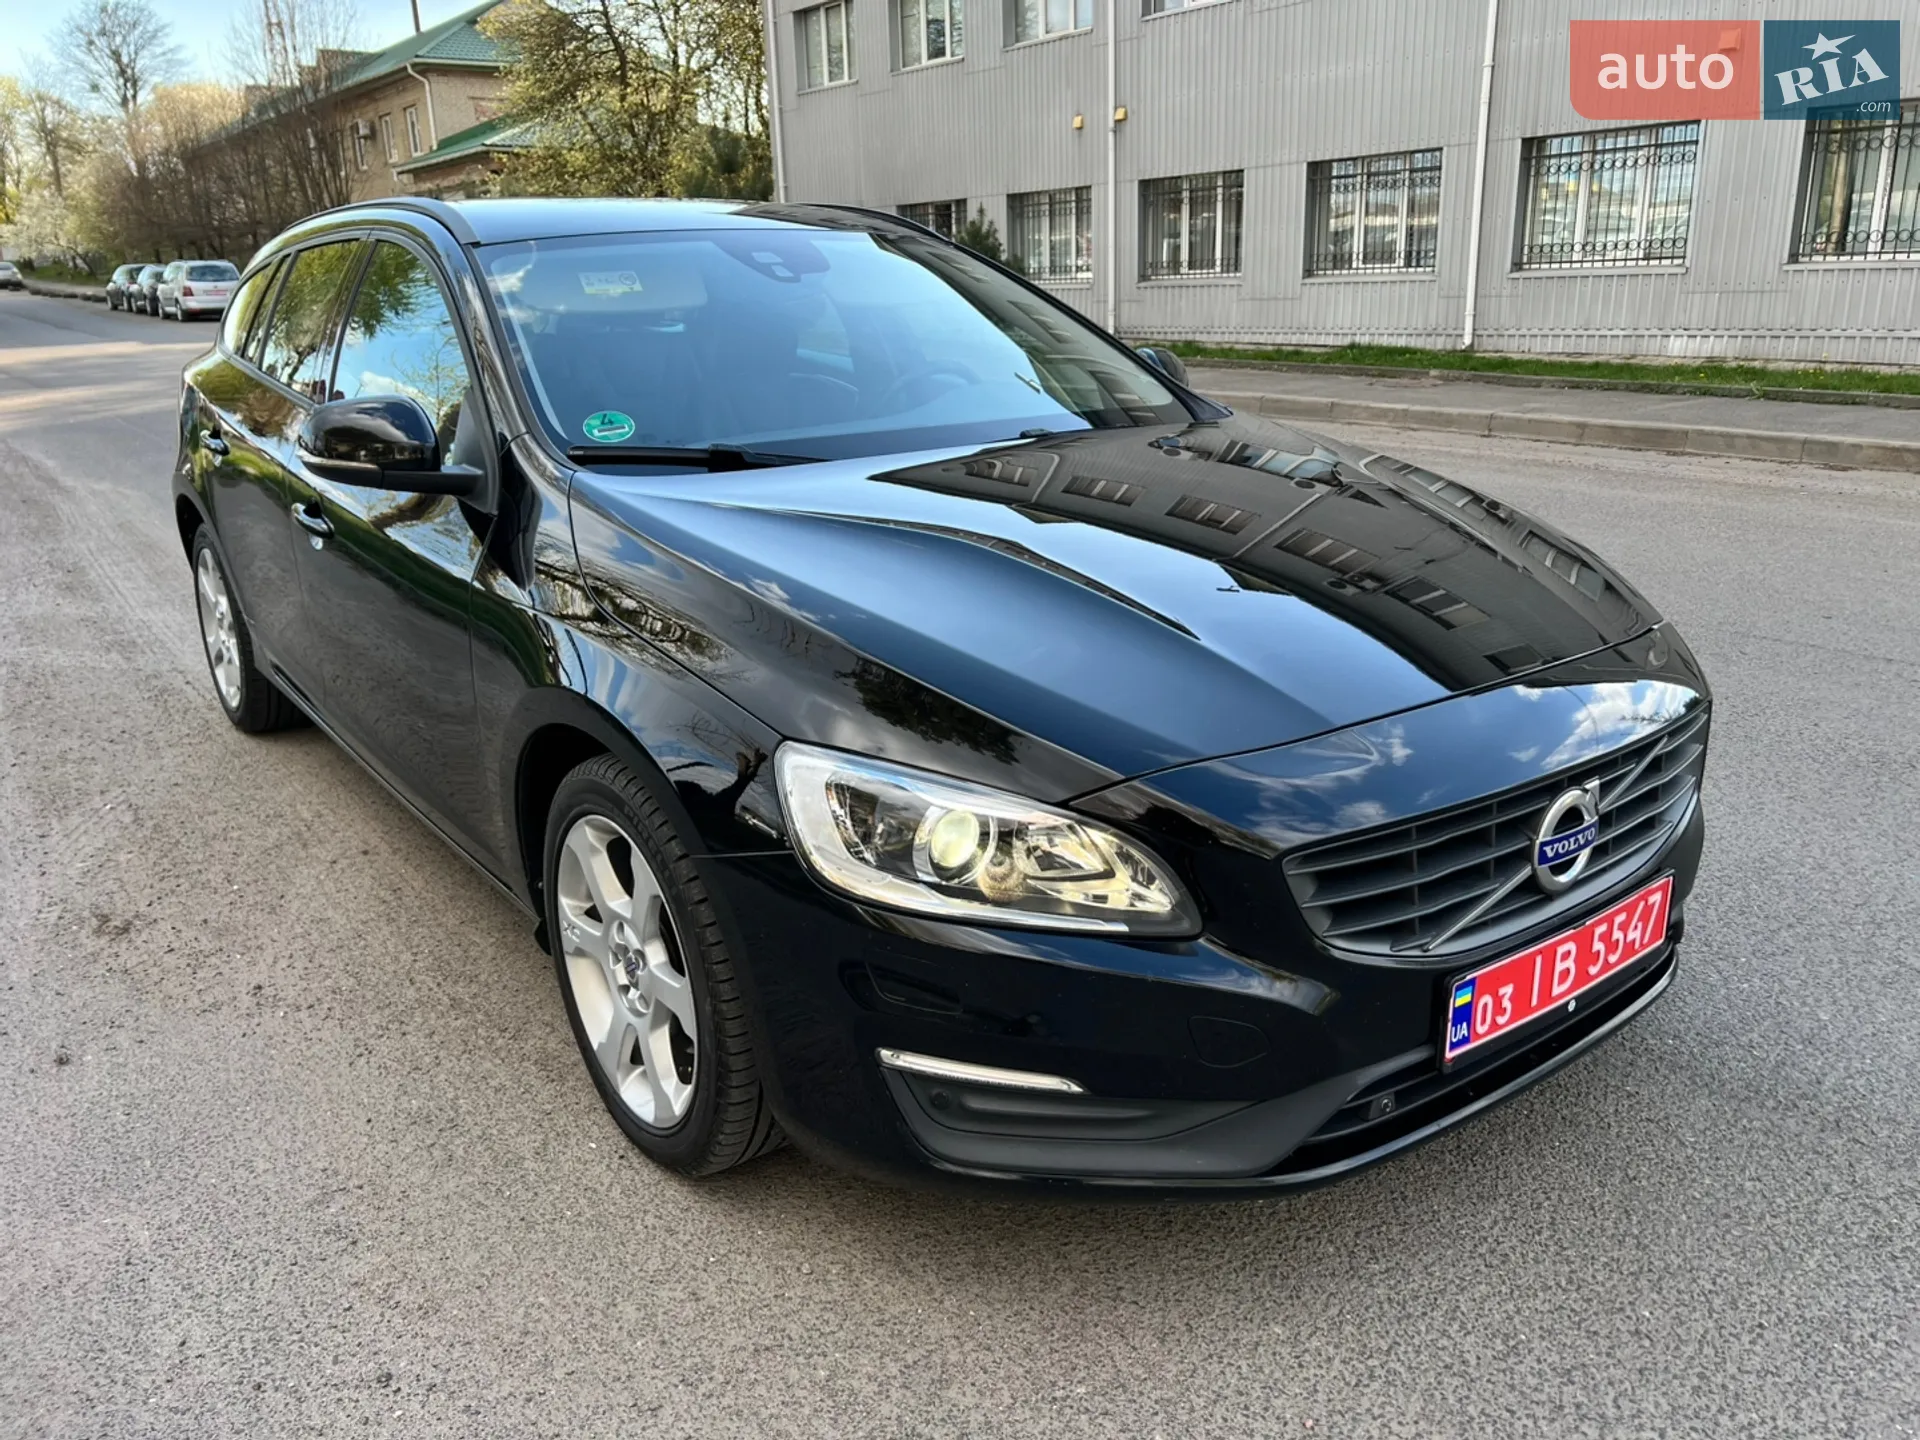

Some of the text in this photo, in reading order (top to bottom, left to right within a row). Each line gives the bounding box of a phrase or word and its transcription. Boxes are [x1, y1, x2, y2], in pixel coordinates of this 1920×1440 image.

[600, 413, 615, 426] 4
[1543, 827, 1596, 858] VOLVO
[1475, 890, 1663, 1035] 03 IB 5547
[1451, 1024, 1469, 1043] UA
